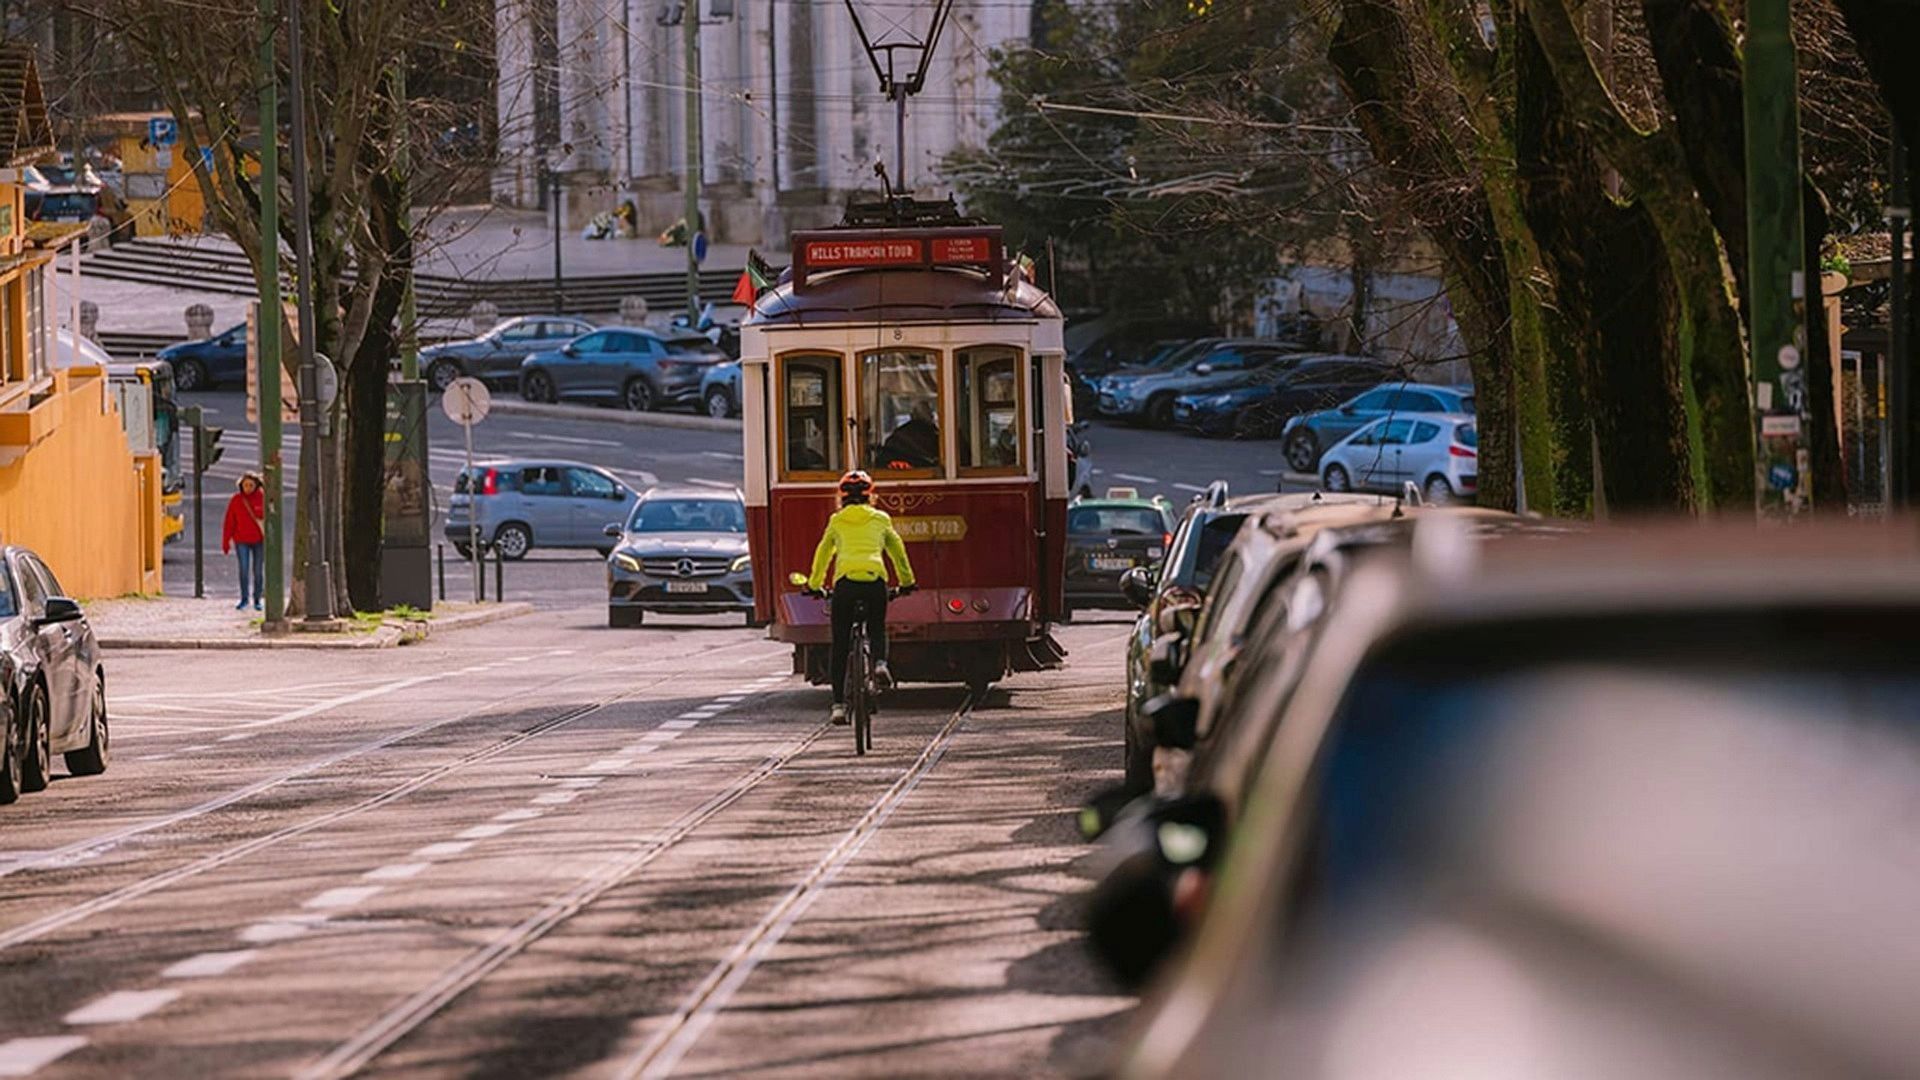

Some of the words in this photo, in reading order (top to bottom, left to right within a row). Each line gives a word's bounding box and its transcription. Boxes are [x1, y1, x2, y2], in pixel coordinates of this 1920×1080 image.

[155, 120, 170, 137] P
[811, 247, 841, 259] HILLS
[888, 245, 913, 258] TOUR
[893, 329, 902, 340] 8
[931, 520, 959, 535] TOUR
